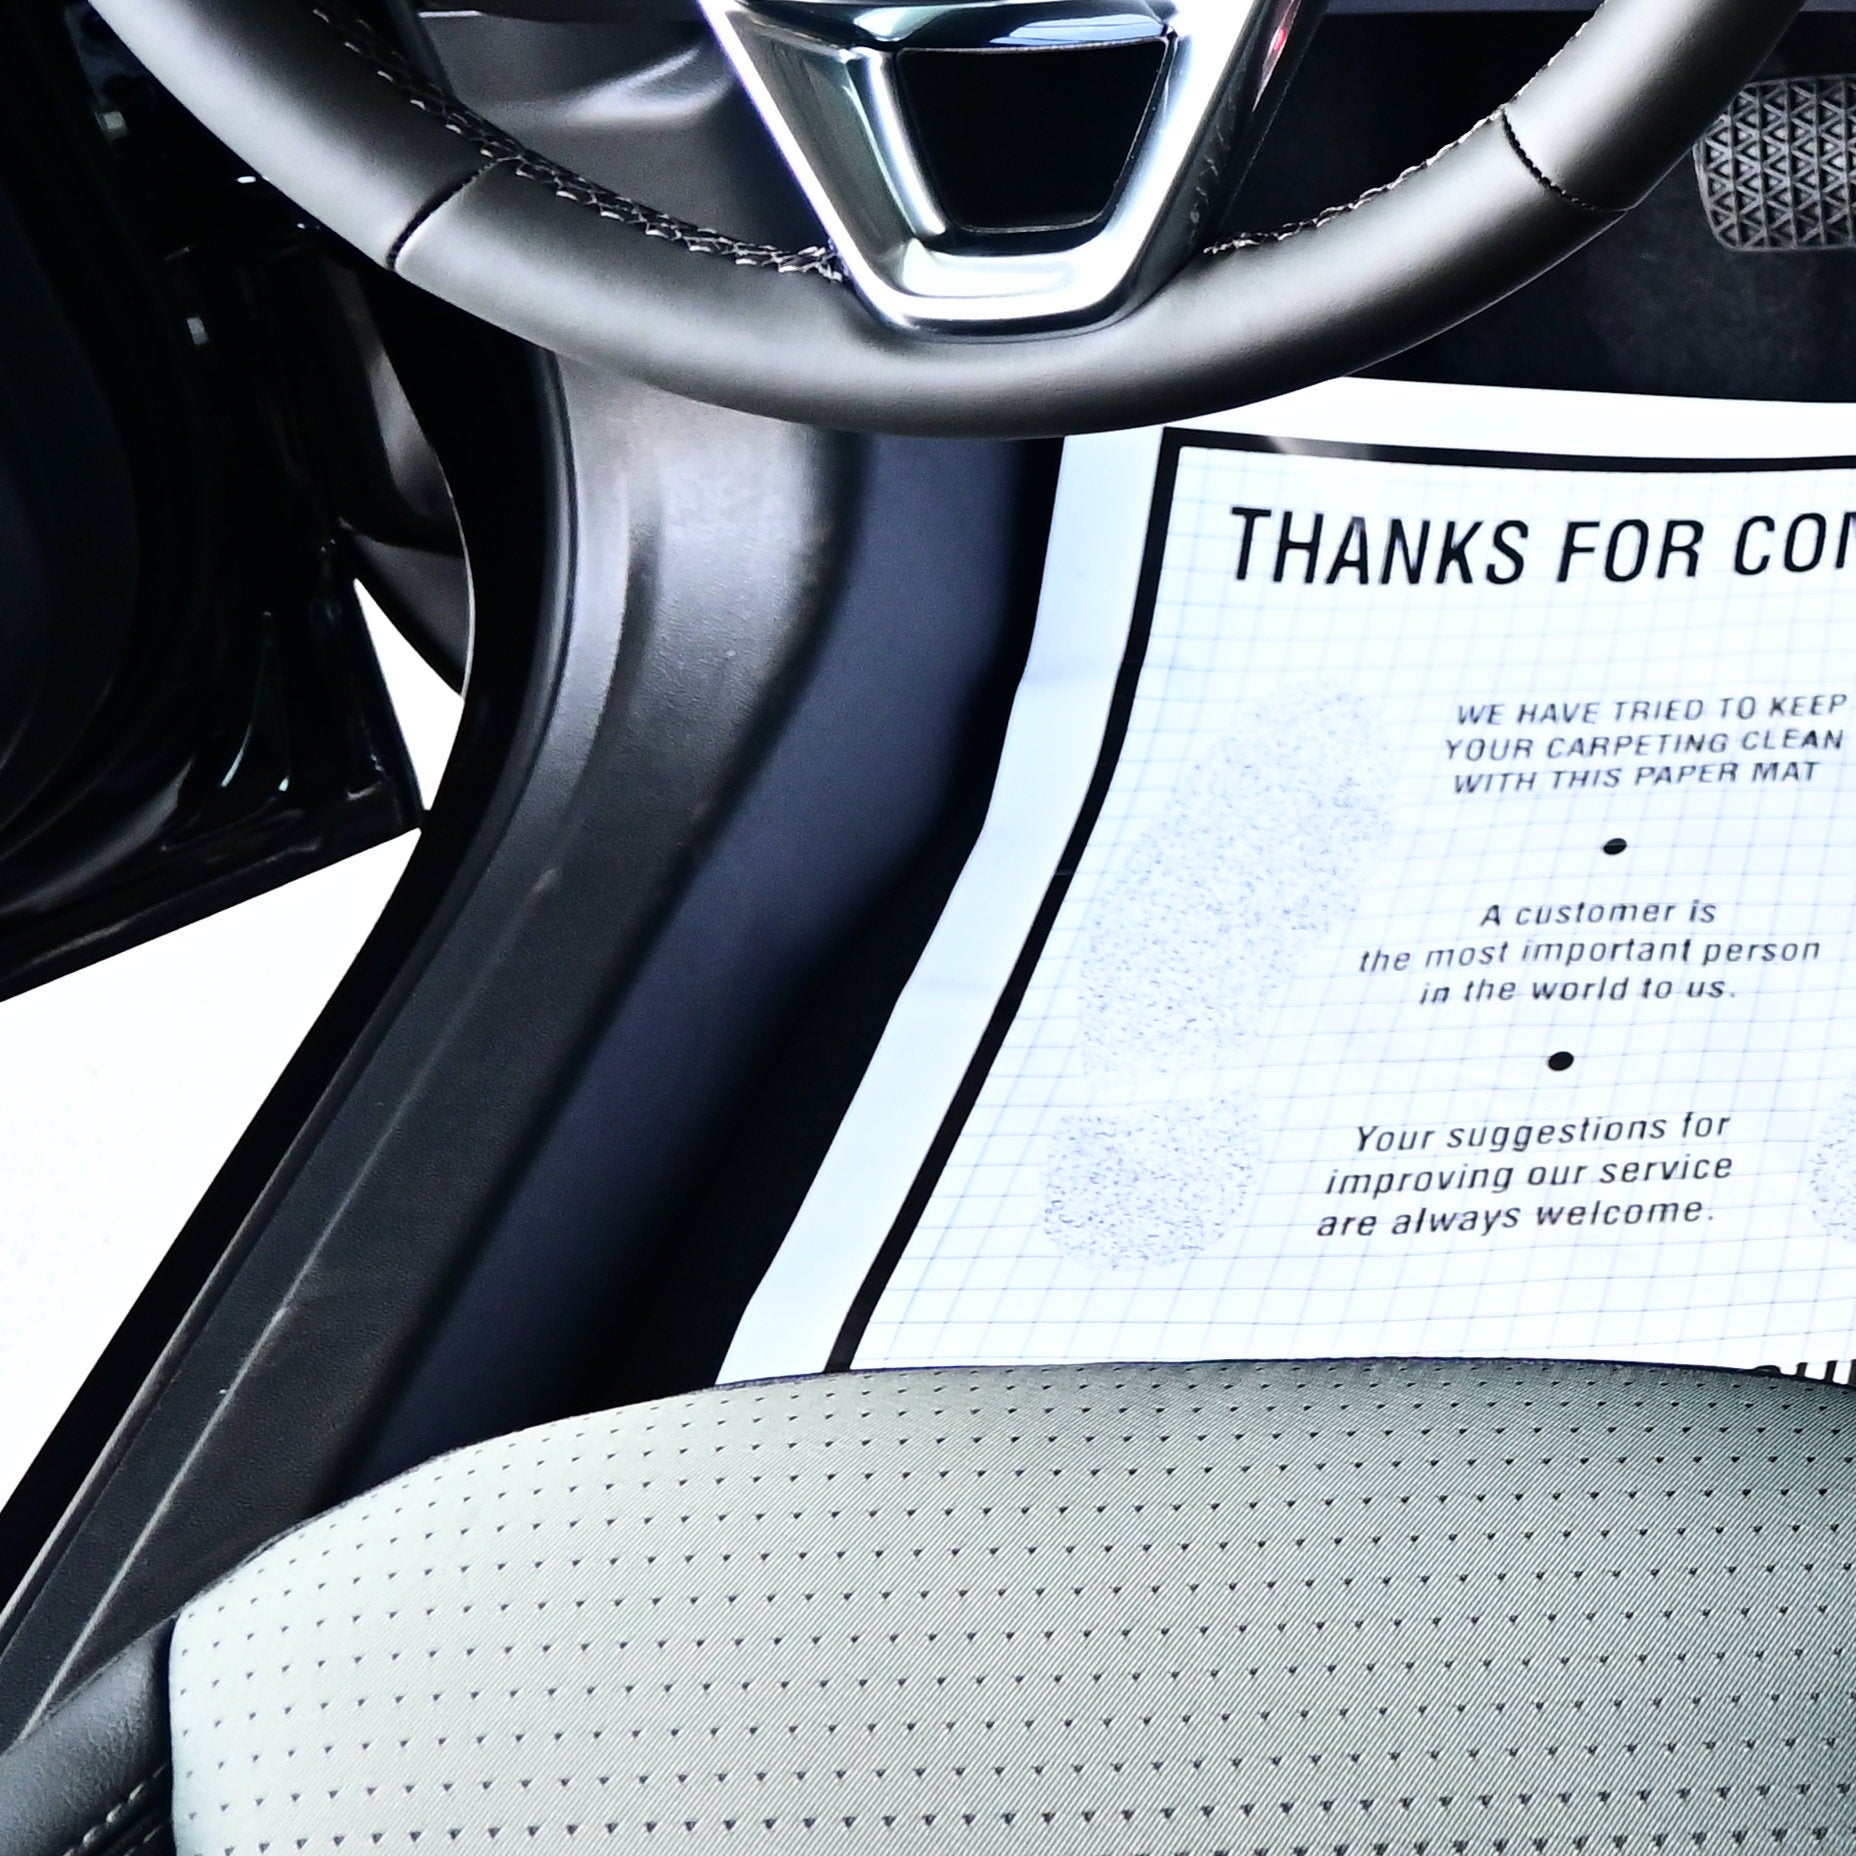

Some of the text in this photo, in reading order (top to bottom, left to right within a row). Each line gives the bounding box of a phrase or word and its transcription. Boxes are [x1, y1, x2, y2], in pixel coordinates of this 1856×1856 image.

[1232, 507, 1528, 584] THANKS
[1557, 519, 1703, 582] FOR
[1459, 694, 1847, 724] WE HAVE TRIED TO KEEP
[1447, 729, 1842, 761] YOUR CARPETING CLEAN
[1455, 762, 1819, 793] WITH THIS PAPER MAT
[1481, 900, 1716, 925] A customer is
[1360, 939, 1819, 972] the most important person
[1420, 977, 1736, 1004] in the world to us.
[1359, 1112, 1730, 1152] Your suggestions for
[1326, 1159, 1732, 1199] improving our service
[1317, 1201, 1715, 1236] are always welcome.
